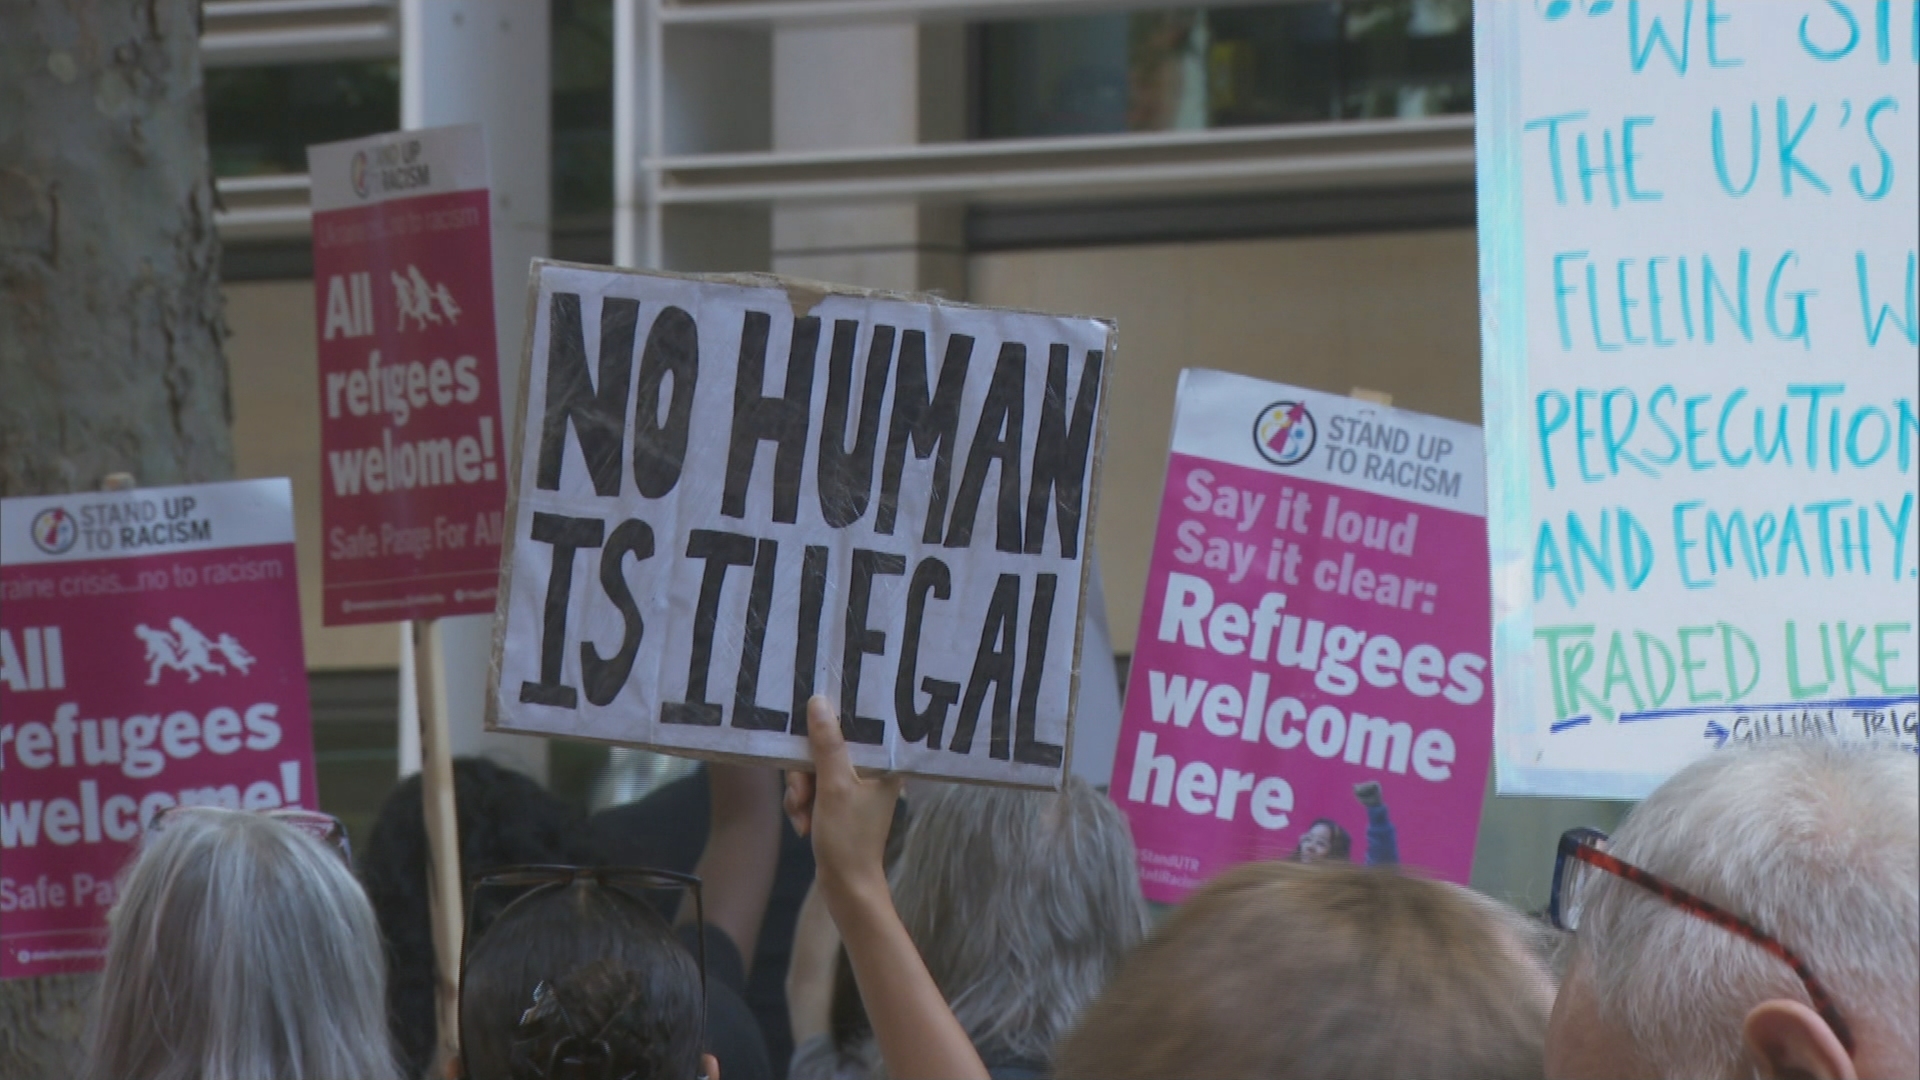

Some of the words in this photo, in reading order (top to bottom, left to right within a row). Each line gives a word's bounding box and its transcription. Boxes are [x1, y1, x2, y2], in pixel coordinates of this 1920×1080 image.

[1523, 109, 1665, 209] THE
[323, 271, 375, 341] All
[1553, 247, 1820, 352] FLEEING
[536, 291, 700, 499] NO
[720, 309, 1105, 560] HUMAN
[1326, 414, 1410, 456] STAND
[1416, 433, 1454, 464] UP
[79, 499, 158, 528] STAND
[163, 496, 197, 521] UP
[1182, 468, 1266, 533] Say
[1275, 486, 1313, 535] it
[1321, 495, 1419, 557] loud
[1324, 443, 1359, 476] TO
[1363, 454, 1463, 499] RACISM
[83, 528, 114, 551] TO
[119, 517, 212, 549] RACISM
[173, 563, 198, 588] to
[203, 556, 283, 584] racism
[434, 515, 469, 550] For
[1173, 519, 1256, 585] Say
[1266, 538, 1303, 586] it
[1313, 552, 1439, 615] clear:
[1532, 505, 1655, 609] AND
[1672, 491, 1918, 590] EMPATHY.
[0, 625, 65, 692] All
[519, 510, 656, 707] IS
[660, 527, 1064, 768] ILLEGAL
[1157, 571, 1488, 706] Refugees
[1533, 618, 1761, 723] TRADED
[1784, 619, 1918, 701] LIKE
[0, 702, 283, 779] refugees
[1148, 669, 1457, 782] welcome
[1127, 730, 1295, 831] here
[0, 876, 67, 912] Safe
[73, 872, 122, 907] Pa
